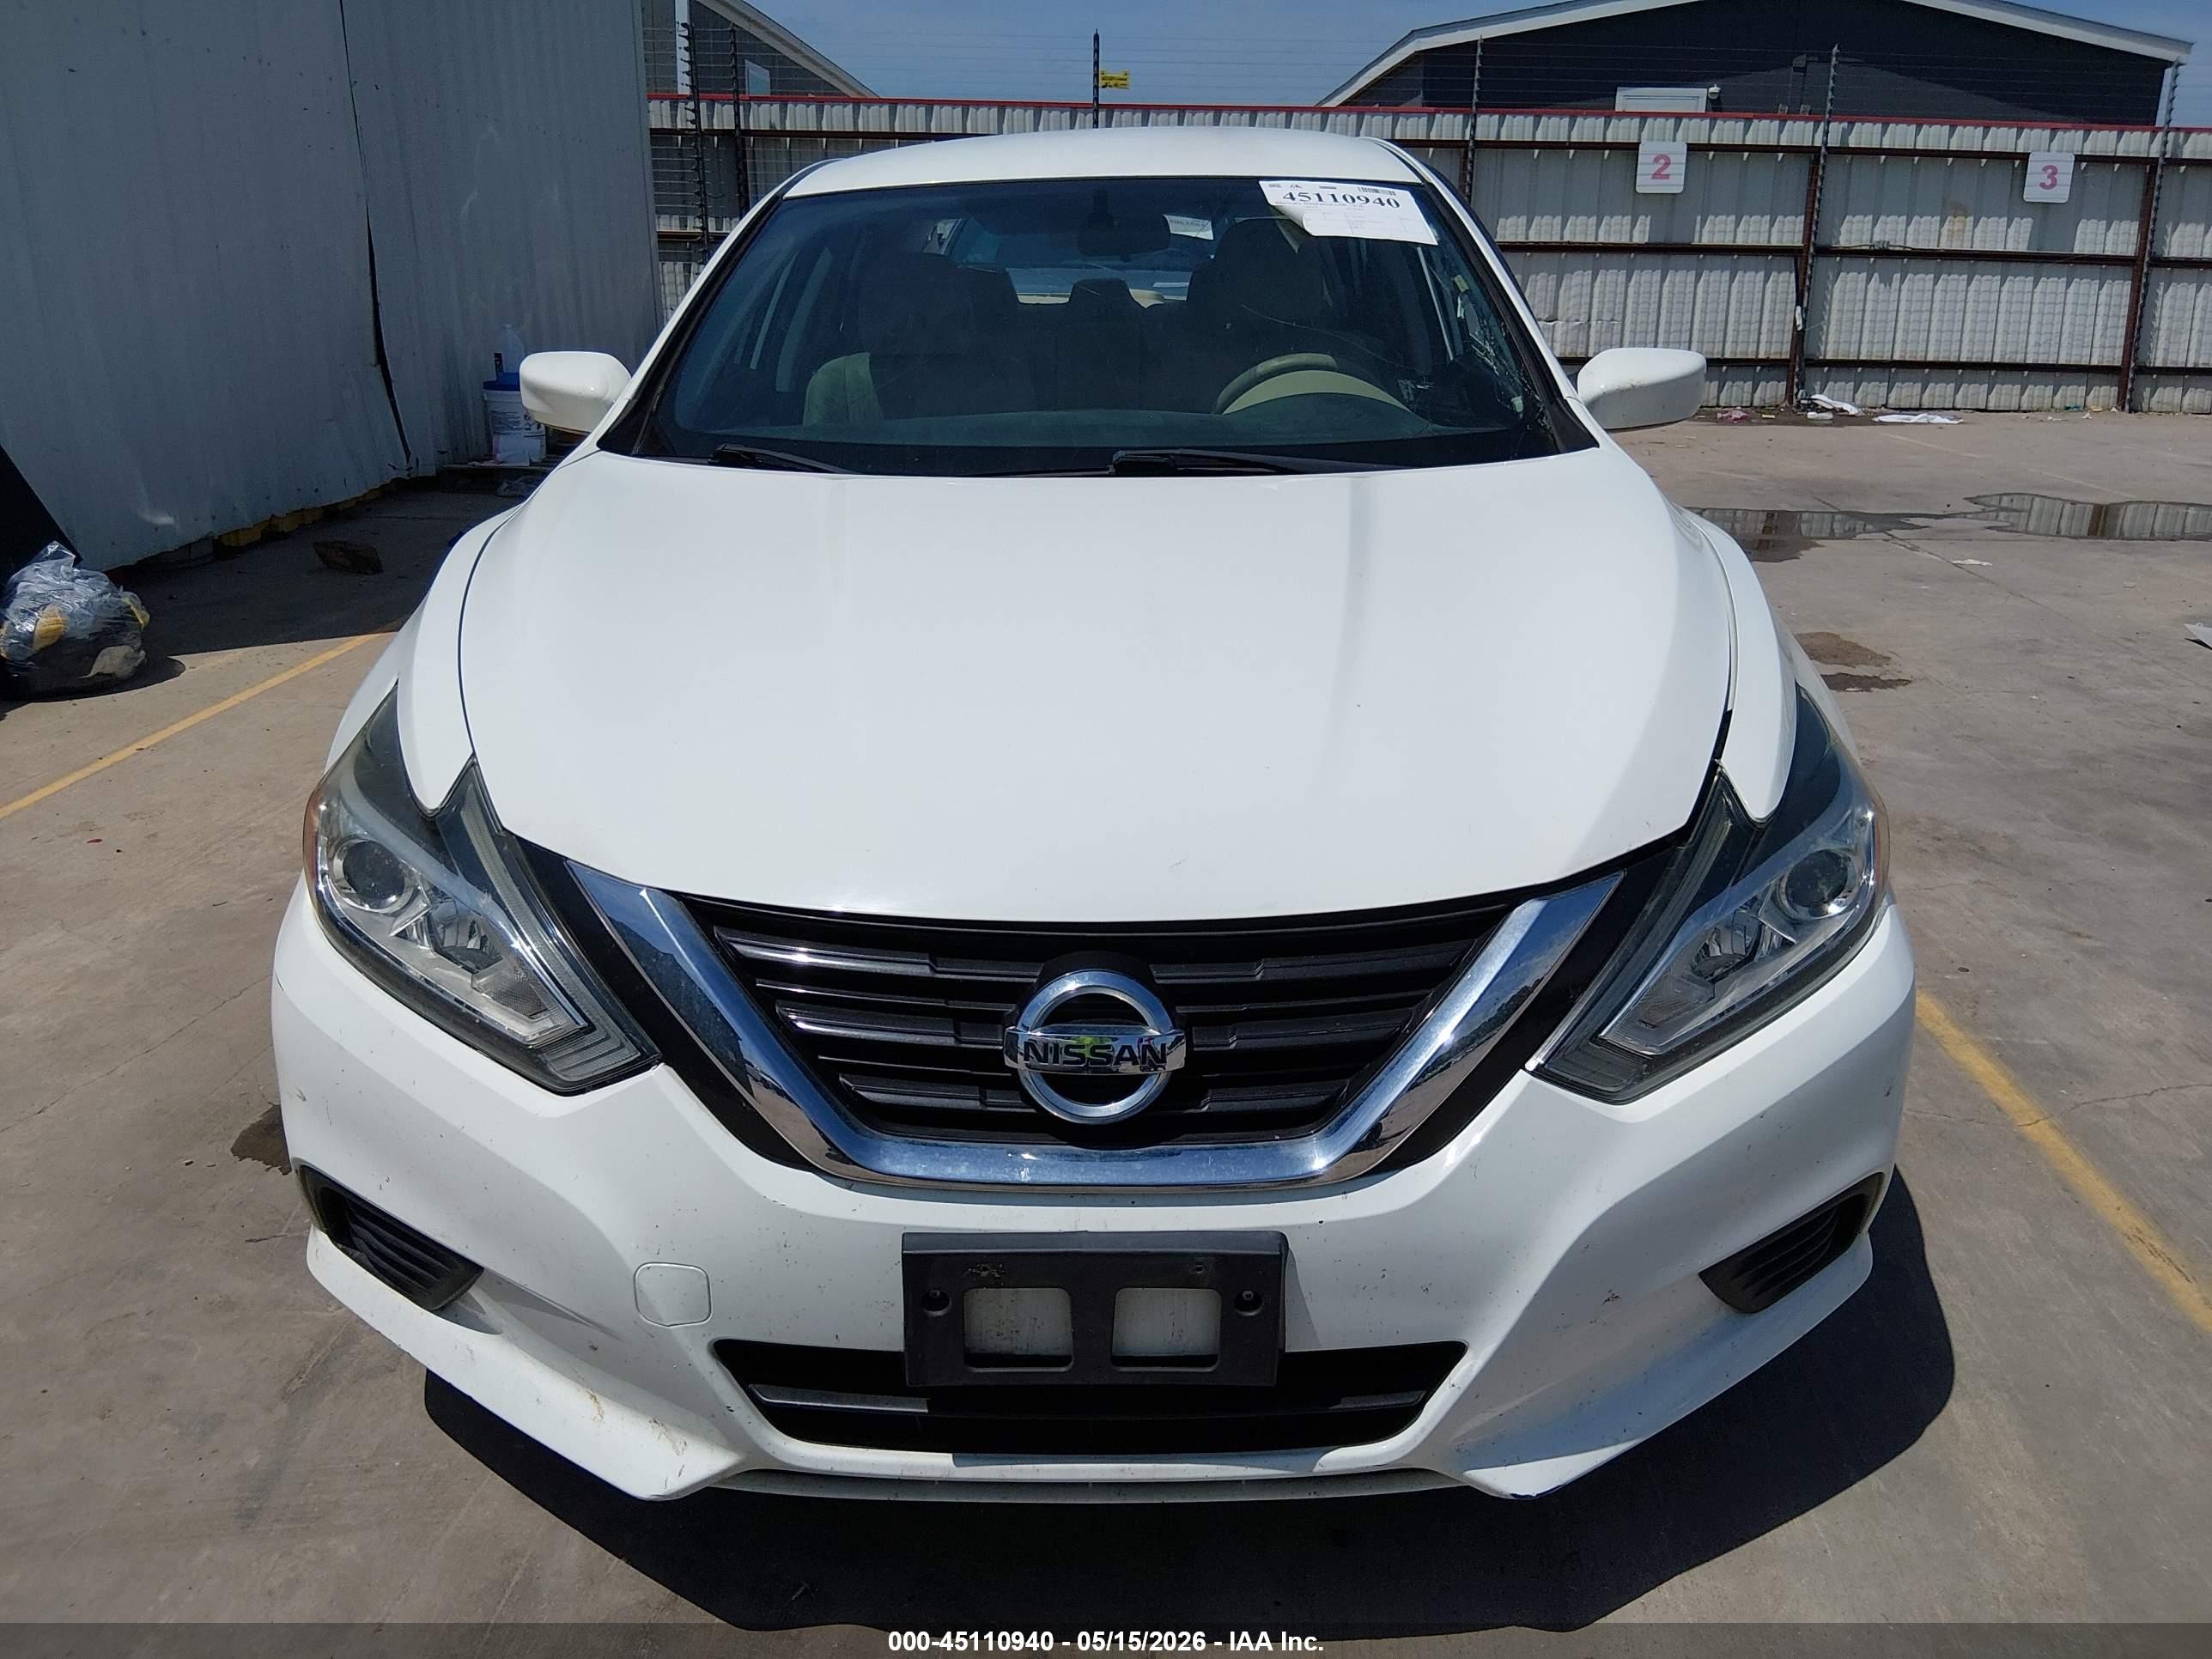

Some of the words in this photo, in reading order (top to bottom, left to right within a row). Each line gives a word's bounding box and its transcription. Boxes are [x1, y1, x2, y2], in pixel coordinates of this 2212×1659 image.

[1651, 154, 1671, 179] 2
[2039, 165, 2058, 191] 3
[1282, 191, 1401, 209] 45110940
[1023, 1040, 1168, 1067] NISSAN
